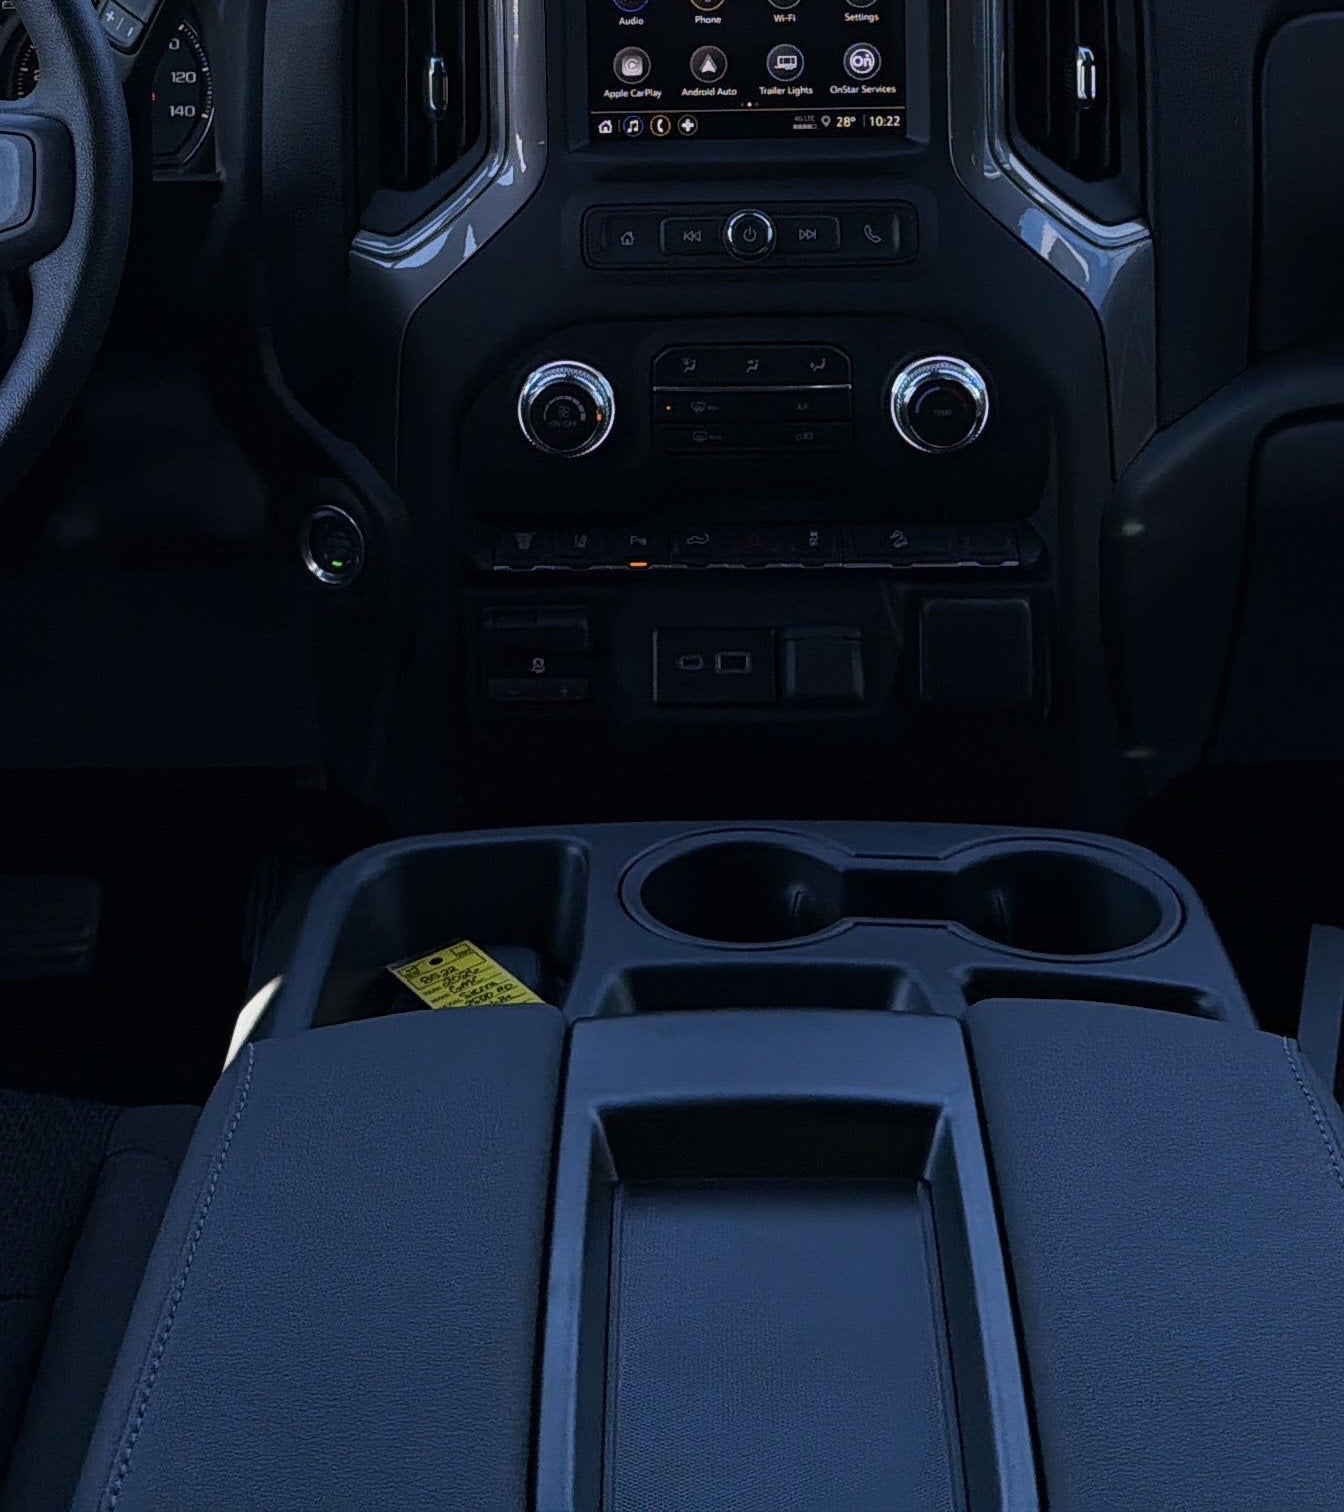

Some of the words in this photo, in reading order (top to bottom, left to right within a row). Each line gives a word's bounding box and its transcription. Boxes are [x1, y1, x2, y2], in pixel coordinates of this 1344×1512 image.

[618, 16, 644, 26] Audio
[694, 15, 722, 24] Phone
[773, 13, 796, 23] Wi-Fi
[844, 12, 880, 24] Settings
[170, 71, 197, 84] 120
[603, 88, 629, 99] Apple
[630, 88, 662, 99] CarPlay
[681, 87, 715, 97] Android
[717, 87, 738, 96] Auto
[759, 86, 785, 95] Trailer
[787, 86, 813, 97] Lights
[829, 85, 859, 94] OnStar
[861, 84, 896, 94] Services
[169, 105, 196, 118] 140
[869, 115, 901, 127] 10:22
